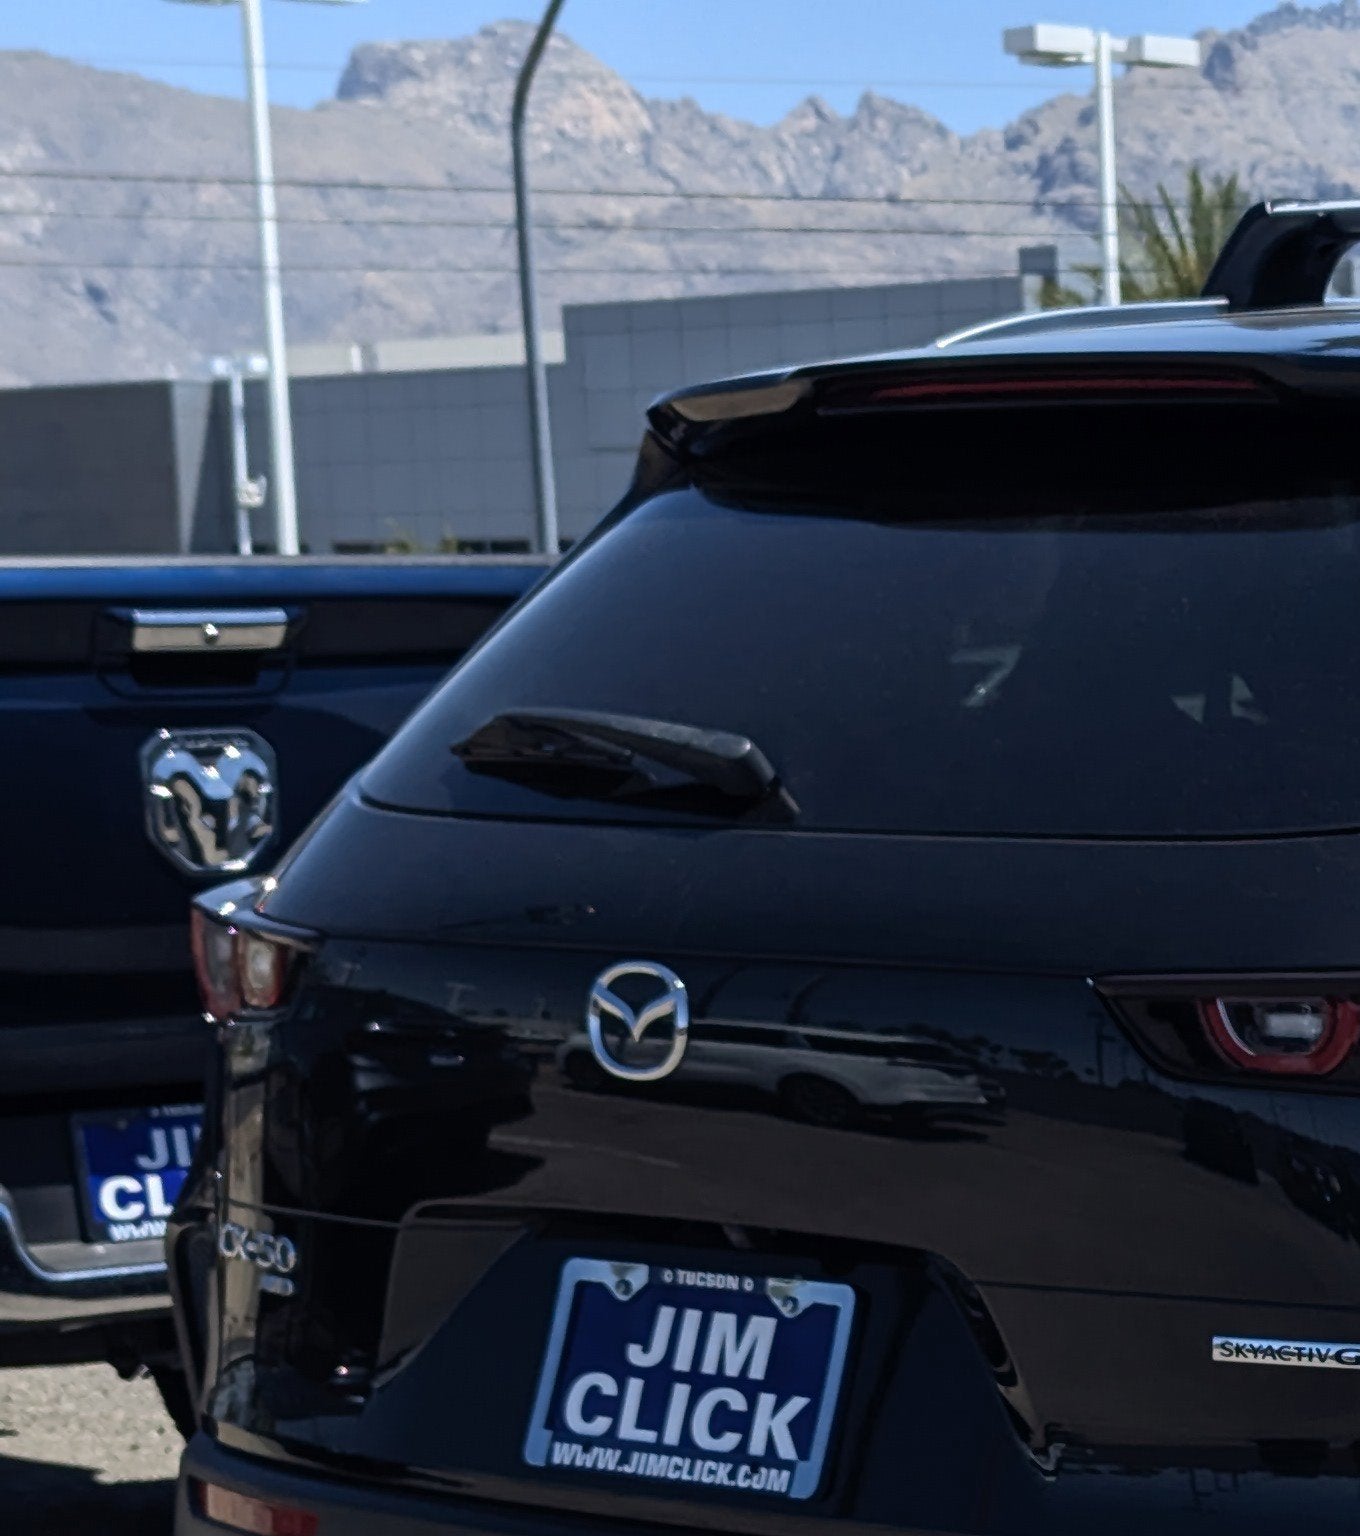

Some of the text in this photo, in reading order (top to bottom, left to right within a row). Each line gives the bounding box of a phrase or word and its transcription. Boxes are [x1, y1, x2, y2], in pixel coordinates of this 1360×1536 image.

[676, 1269, 740, 1291] TUCSON
[625, 1304, 778, 1381] JIM
[564, 1371, 812, 1461] CLICK
[550, 1440, 792, 1494] WWW.JIMCLICK.COM
